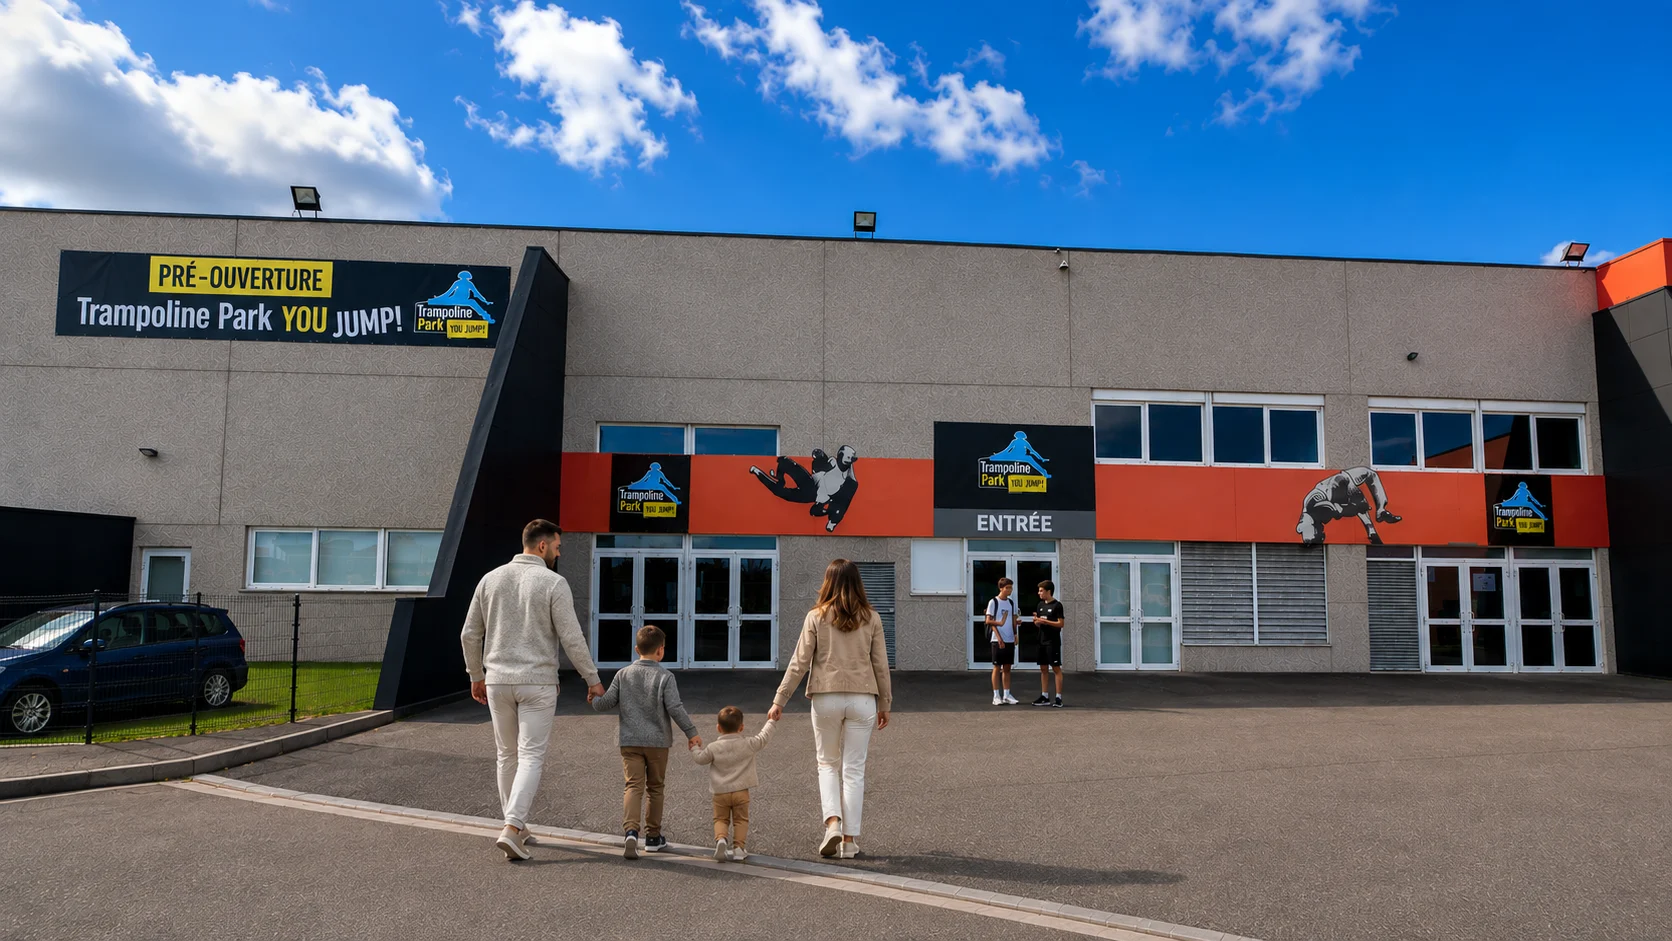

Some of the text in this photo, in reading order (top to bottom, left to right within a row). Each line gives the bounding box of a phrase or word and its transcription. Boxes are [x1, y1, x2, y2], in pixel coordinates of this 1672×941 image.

[158, 260, 323, 292] PRÉ-OUVERTURE
[77, 297, 403, 338] Trampoline Park YOU JUMP!
[417, 304, 473, 320] Trampoline
[418, 318, 444, 331] Park
[450, 325, 486, 334] YOU JUMP!
[980, 461, 1031, 475] Trampoline
[981, 474, 1005, 486] Park
[620, 489, 664, 501] Trampoline
[620, 500, 641, 511] Park
[977, 511, 1052, 532] ENTRÉE
